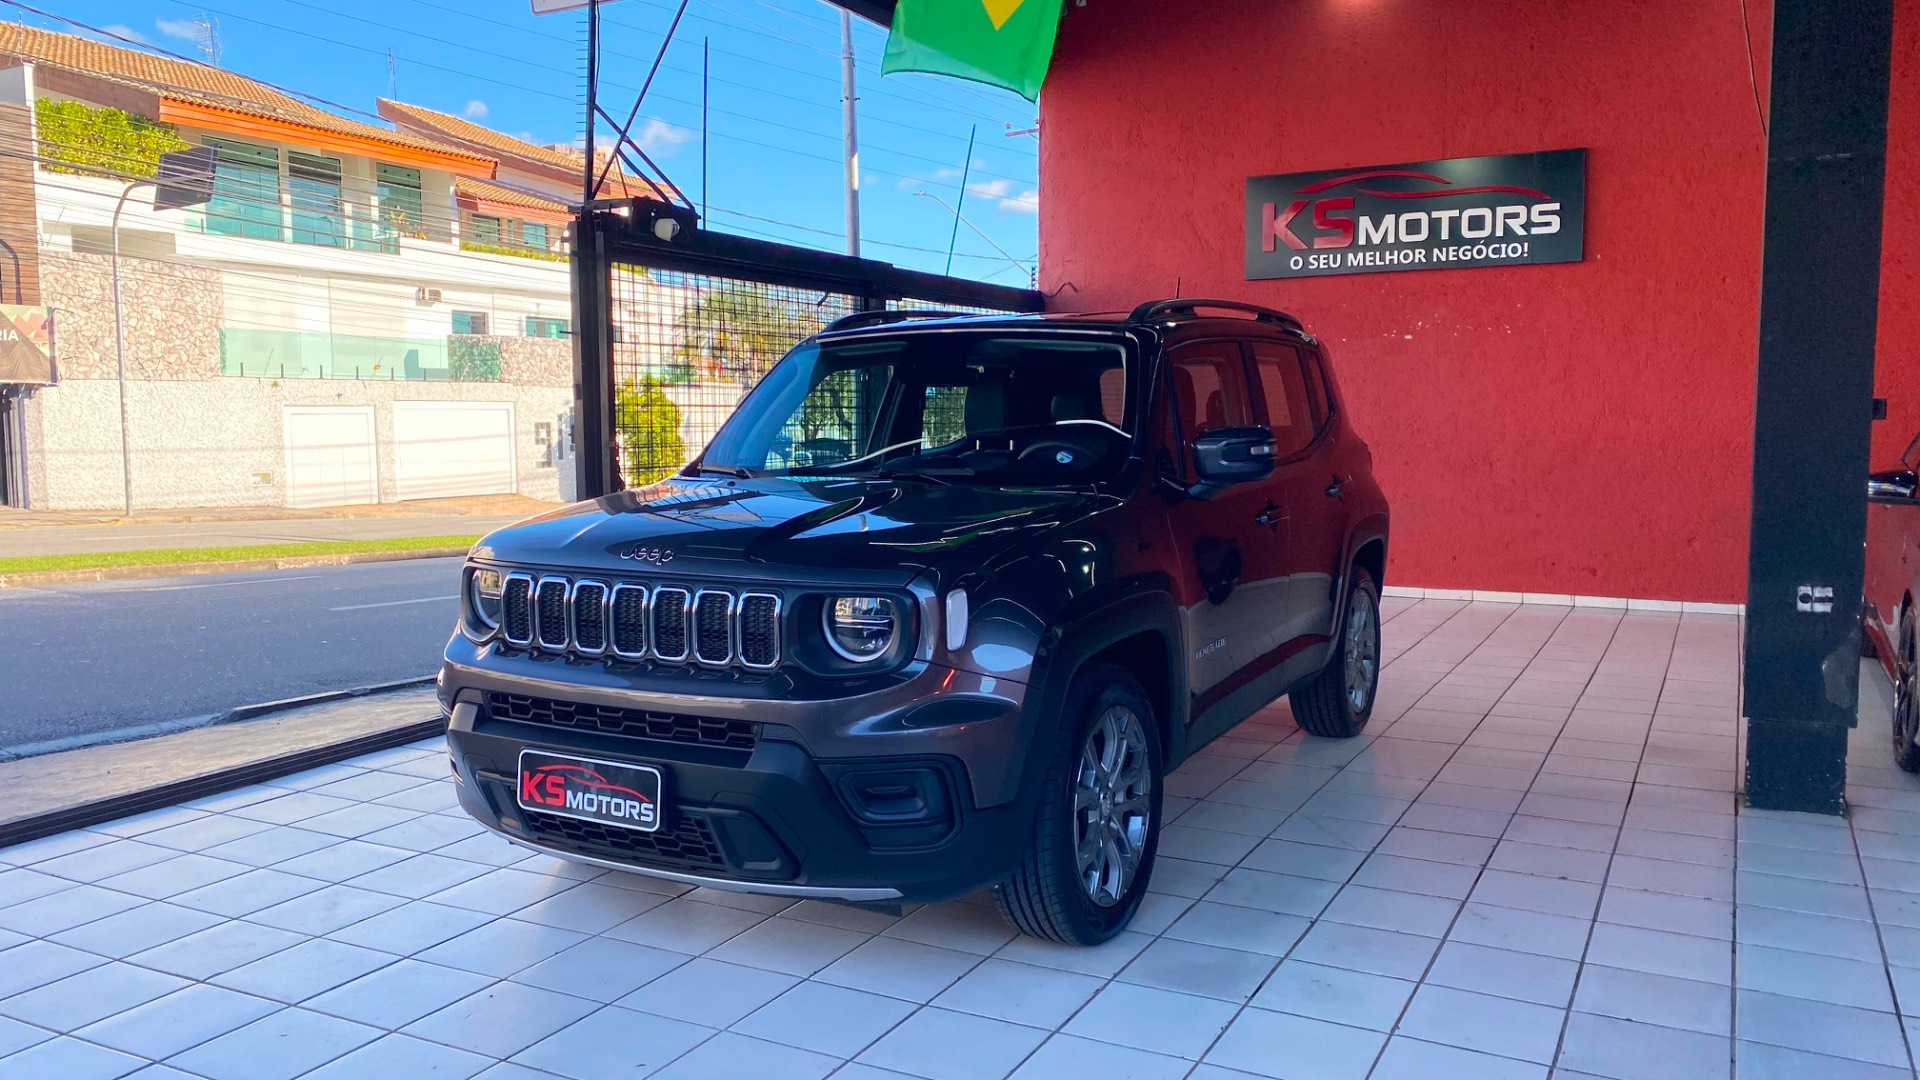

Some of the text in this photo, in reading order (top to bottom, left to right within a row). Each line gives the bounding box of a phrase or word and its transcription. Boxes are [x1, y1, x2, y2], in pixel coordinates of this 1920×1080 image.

[1262, 198, 1561, 252] KS MOTORS
[1290, 239, 1529, 270] O SEU MELHOR NEGÓCIO!
[620, 542, 675, 566] Jeep
[522, 770, 654, 823] KS MOTORS
